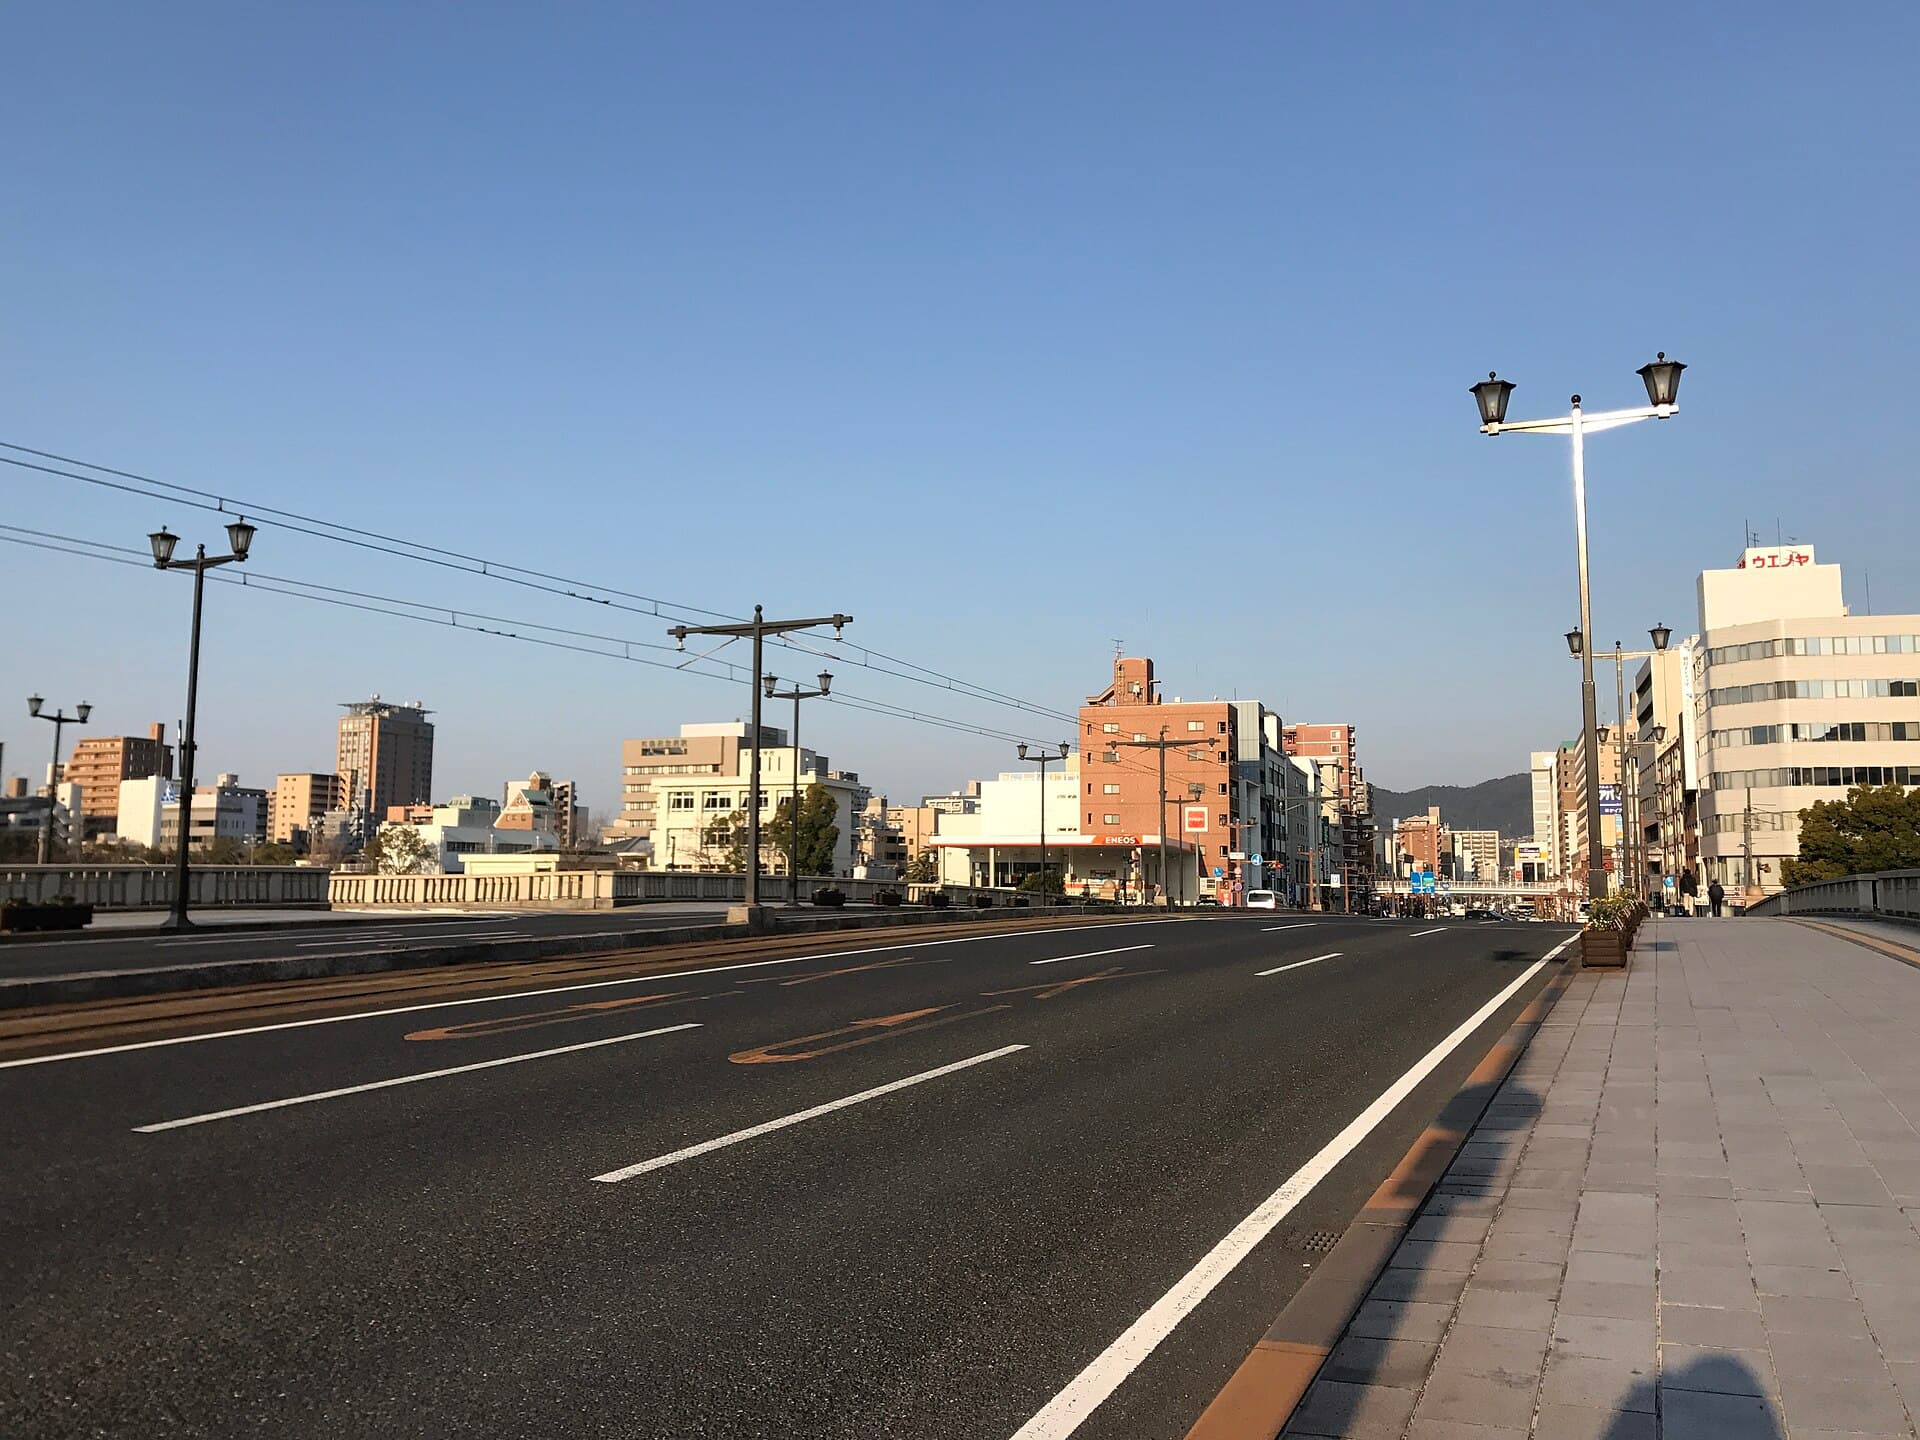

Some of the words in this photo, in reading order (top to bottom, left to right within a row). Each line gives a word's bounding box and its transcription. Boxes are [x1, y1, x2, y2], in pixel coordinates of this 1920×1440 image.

[1753, 553, 1809, 568] ウエノヤ
[1105, 836, 1136, 844] ENEOS
